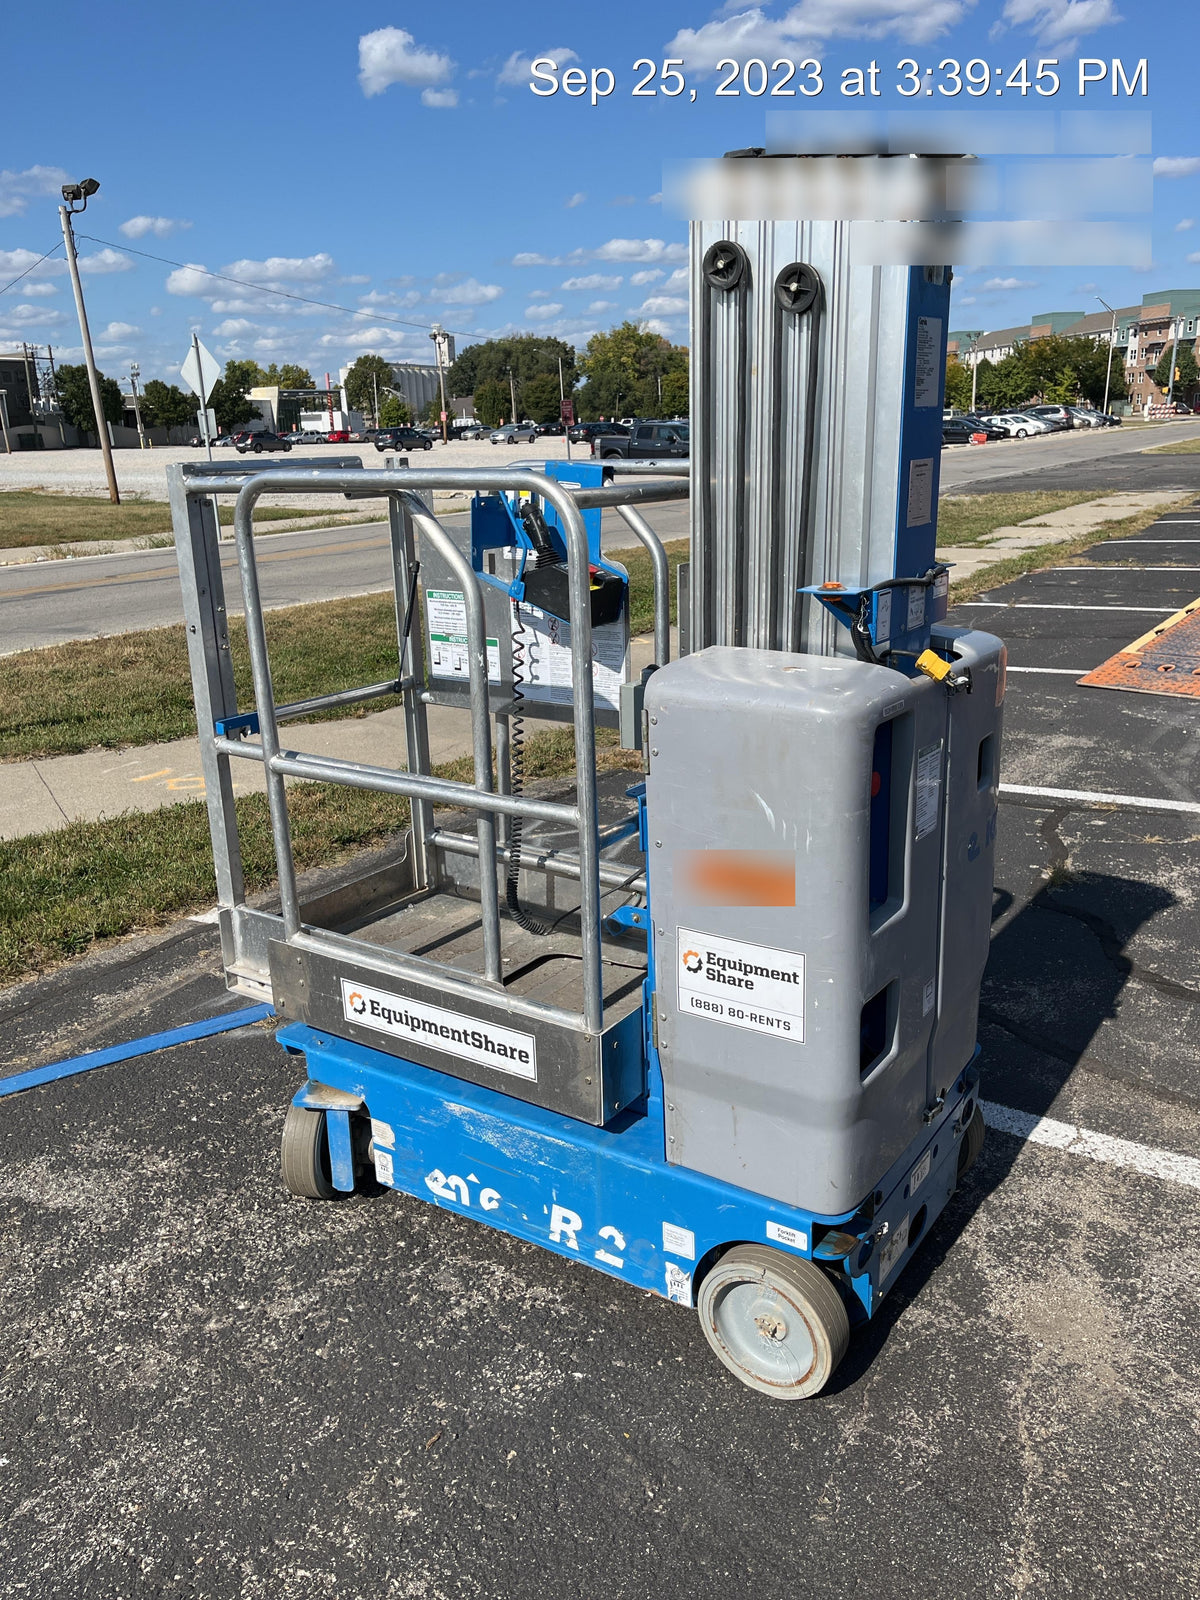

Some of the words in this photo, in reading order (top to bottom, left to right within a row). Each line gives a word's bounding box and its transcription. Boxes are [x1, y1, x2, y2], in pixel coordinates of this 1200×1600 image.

[706, 951, 800, 985] Equipment
[706, 968, 755, 990] Share
[690, 996, 724, 1015] (888)
[728, 1006, 791, 1031] 80-RENTS
[368, 999, 530, 1064] EquipmentShare
[777, 1227, 796, 1238] Forklift
[777, 1233, 796, 1244] Pocket
